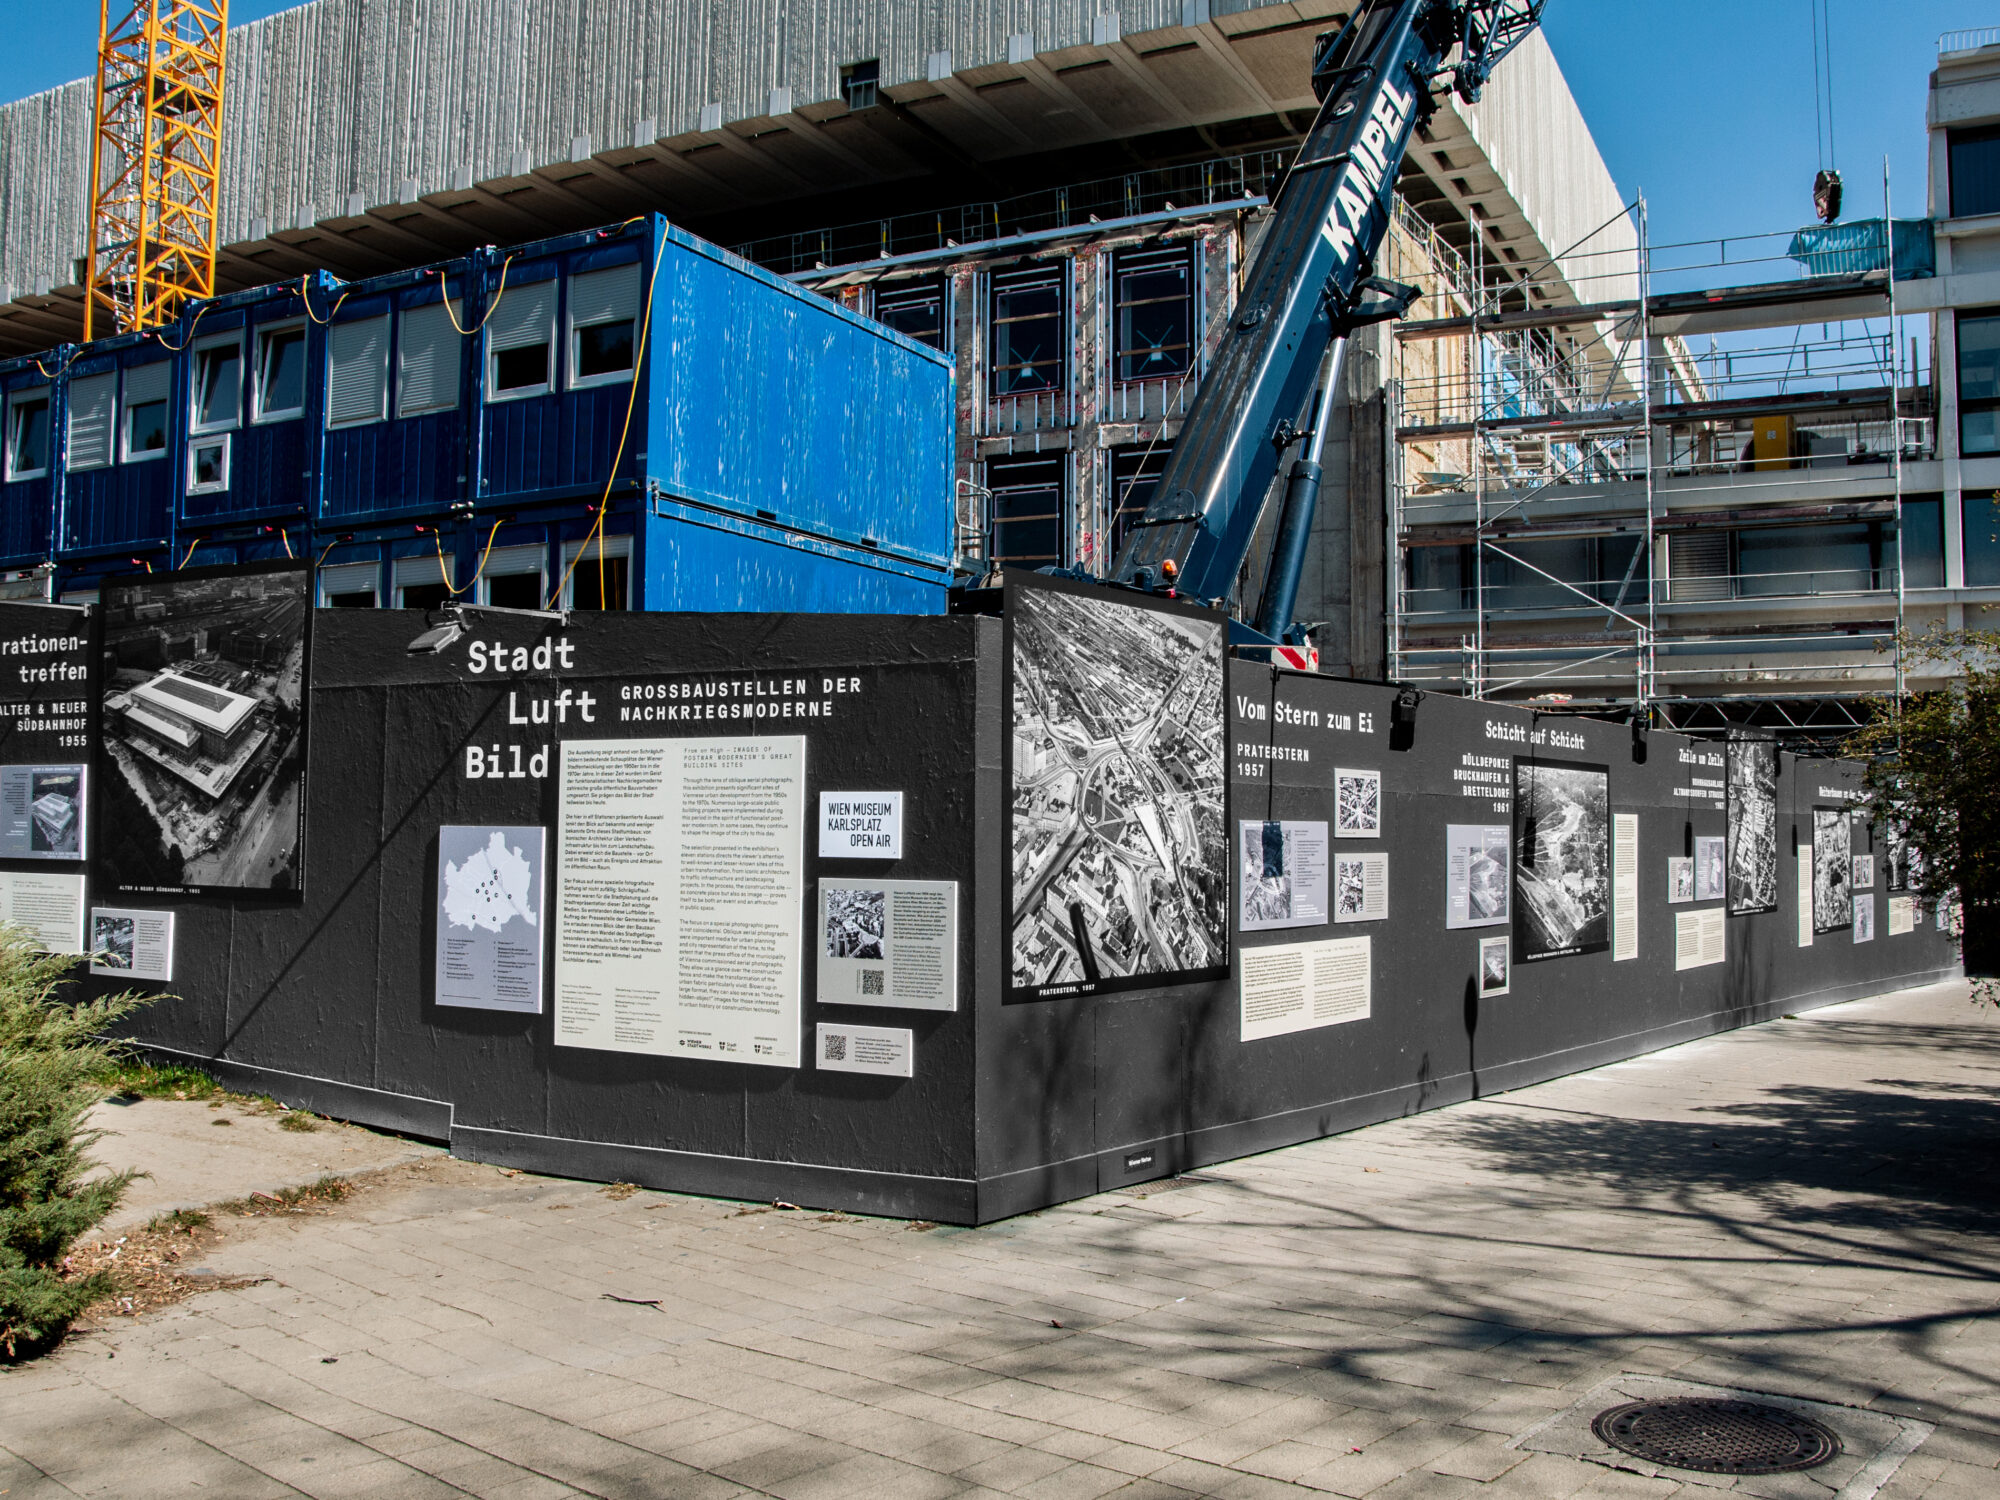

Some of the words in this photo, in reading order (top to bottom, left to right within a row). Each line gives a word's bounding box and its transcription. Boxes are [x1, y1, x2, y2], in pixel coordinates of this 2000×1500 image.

[1321, 79, 1412, 264] KAMPEL
[2, 634, 87, 655] rationen-
[468, 637, 575, 674] Stadt
[19, 662, 87, 683] treffen
[621, 679, 807, 700] GROSSBAUSTELLEN
[823, 677, 861, 694] DER
[38, 704, 44, 715] &
[53, 702, 87, 713] NEUER
[509, 688, 597, 725] Luft
[621, 701, 833, 722] NACHKRIEGSMODERNE
[1237, 696, 1266, 720] Vom
[1275, 701, 1318, 726] Stern
[1327, 713, 1350, 730] zum
[1359, 712, 1374, 733] Ei
[18, 718, 87, 731] SÜDBAHNHOF
[59, 735, 87, 746] 1955
[1486, 720, 1526, 742] Schicht
[1530, 729, 1546, 744] auf
[1551, 730, 1584, 750] Schicht
[1237, 744, 1309, 761] PRATERSTERN
[1462, 753, 1510, 769] MÜLLDEPONIE
[1679, 749, 1696, 763] Zeile
[1708, 752, 1724, 766] Zeile
[466, 744, 549, 779] Bild
[1238, 763, 1264, 777] 1957
[1454, 770, 1501, 783] BRUCKHAUFEN
[1463, 786, 1510, 798] BRETTELDORF
[828, 803, 850, 815] WIEN
[853, 803, 891, 815] MUSEUM
[1493, 803, 1509, 813] 1961
[828, 818, 882, 831] KARLSPLATZ
[850, 834, 873, 847] OPEN
[876, 835, 891, 847] AIR
